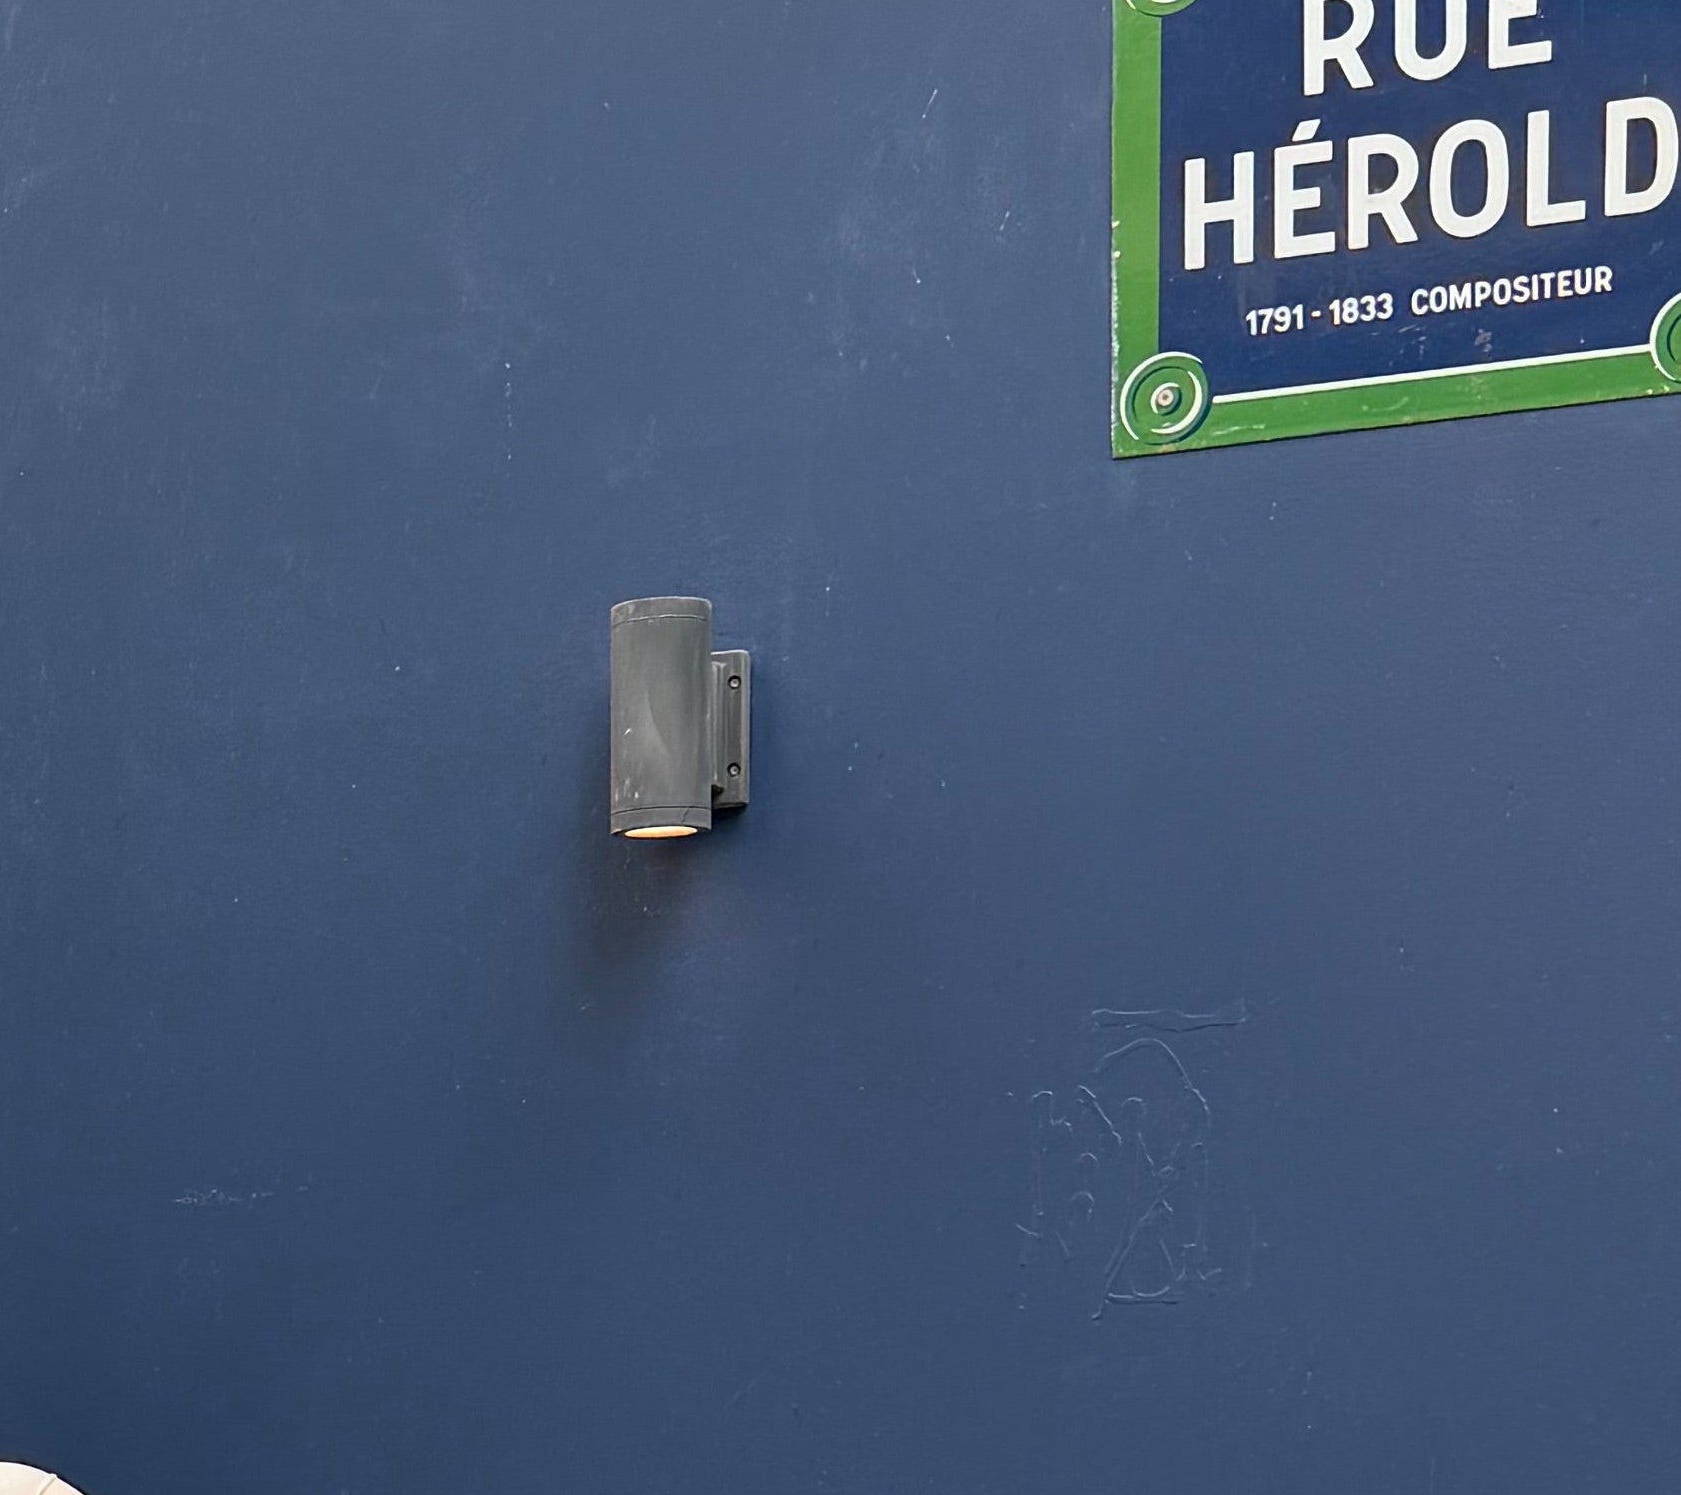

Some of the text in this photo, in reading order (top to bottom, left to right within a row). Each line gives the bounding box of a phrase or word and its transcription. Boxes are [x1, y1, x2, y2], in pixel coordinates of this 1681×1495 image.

[1303, 0, 1551, 96] RUE
[1184, 96, 1679, 270] HÉROLD
[1410, 265, 1613, 316] COMPOSITEUR
